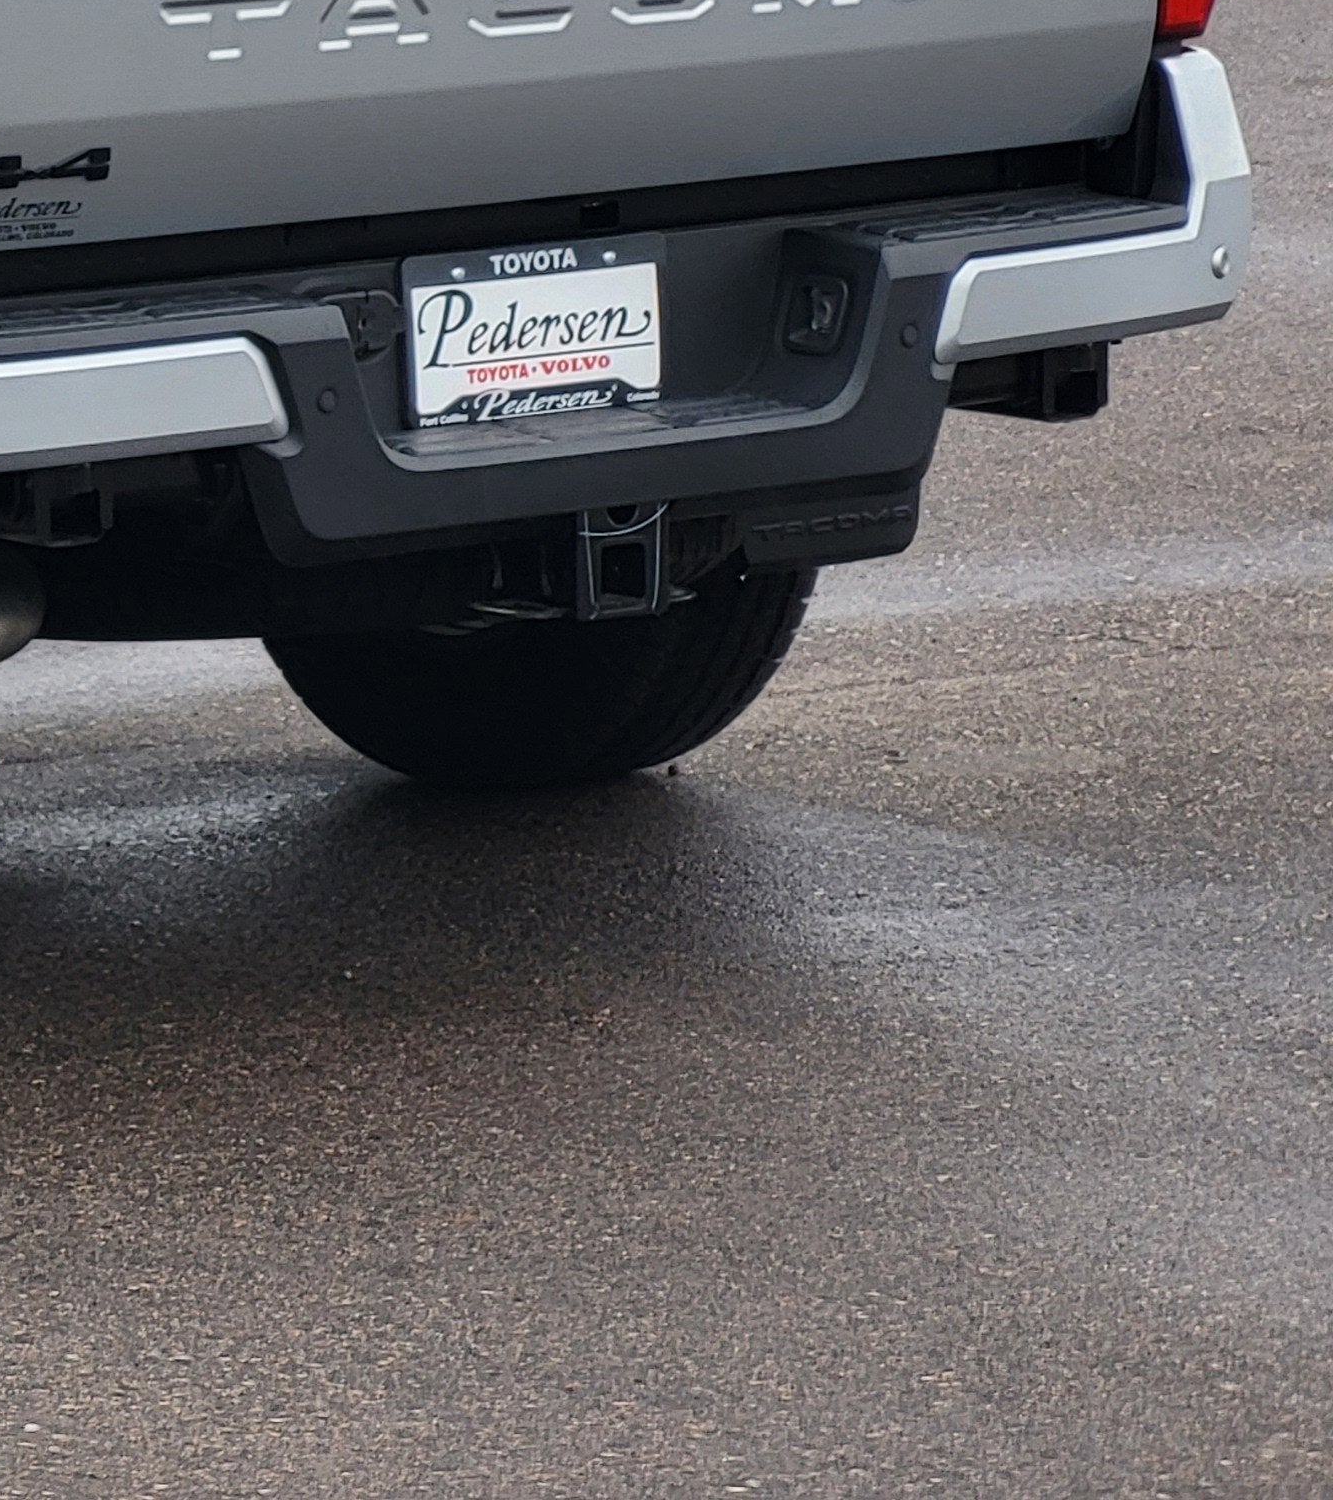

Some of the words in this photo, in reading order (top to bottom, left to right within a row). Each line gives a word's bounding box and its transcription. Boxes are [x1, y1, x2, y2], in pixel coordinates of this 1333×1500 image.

[489, 248, 578, 276] TOYOTA
[418, 289, 652, 370] Pedersen
[467, 363, 530, 384] TOYOTA
[539, 355, 611, 376] VOLVO
[474, 387, 618, 421] Pedersen
